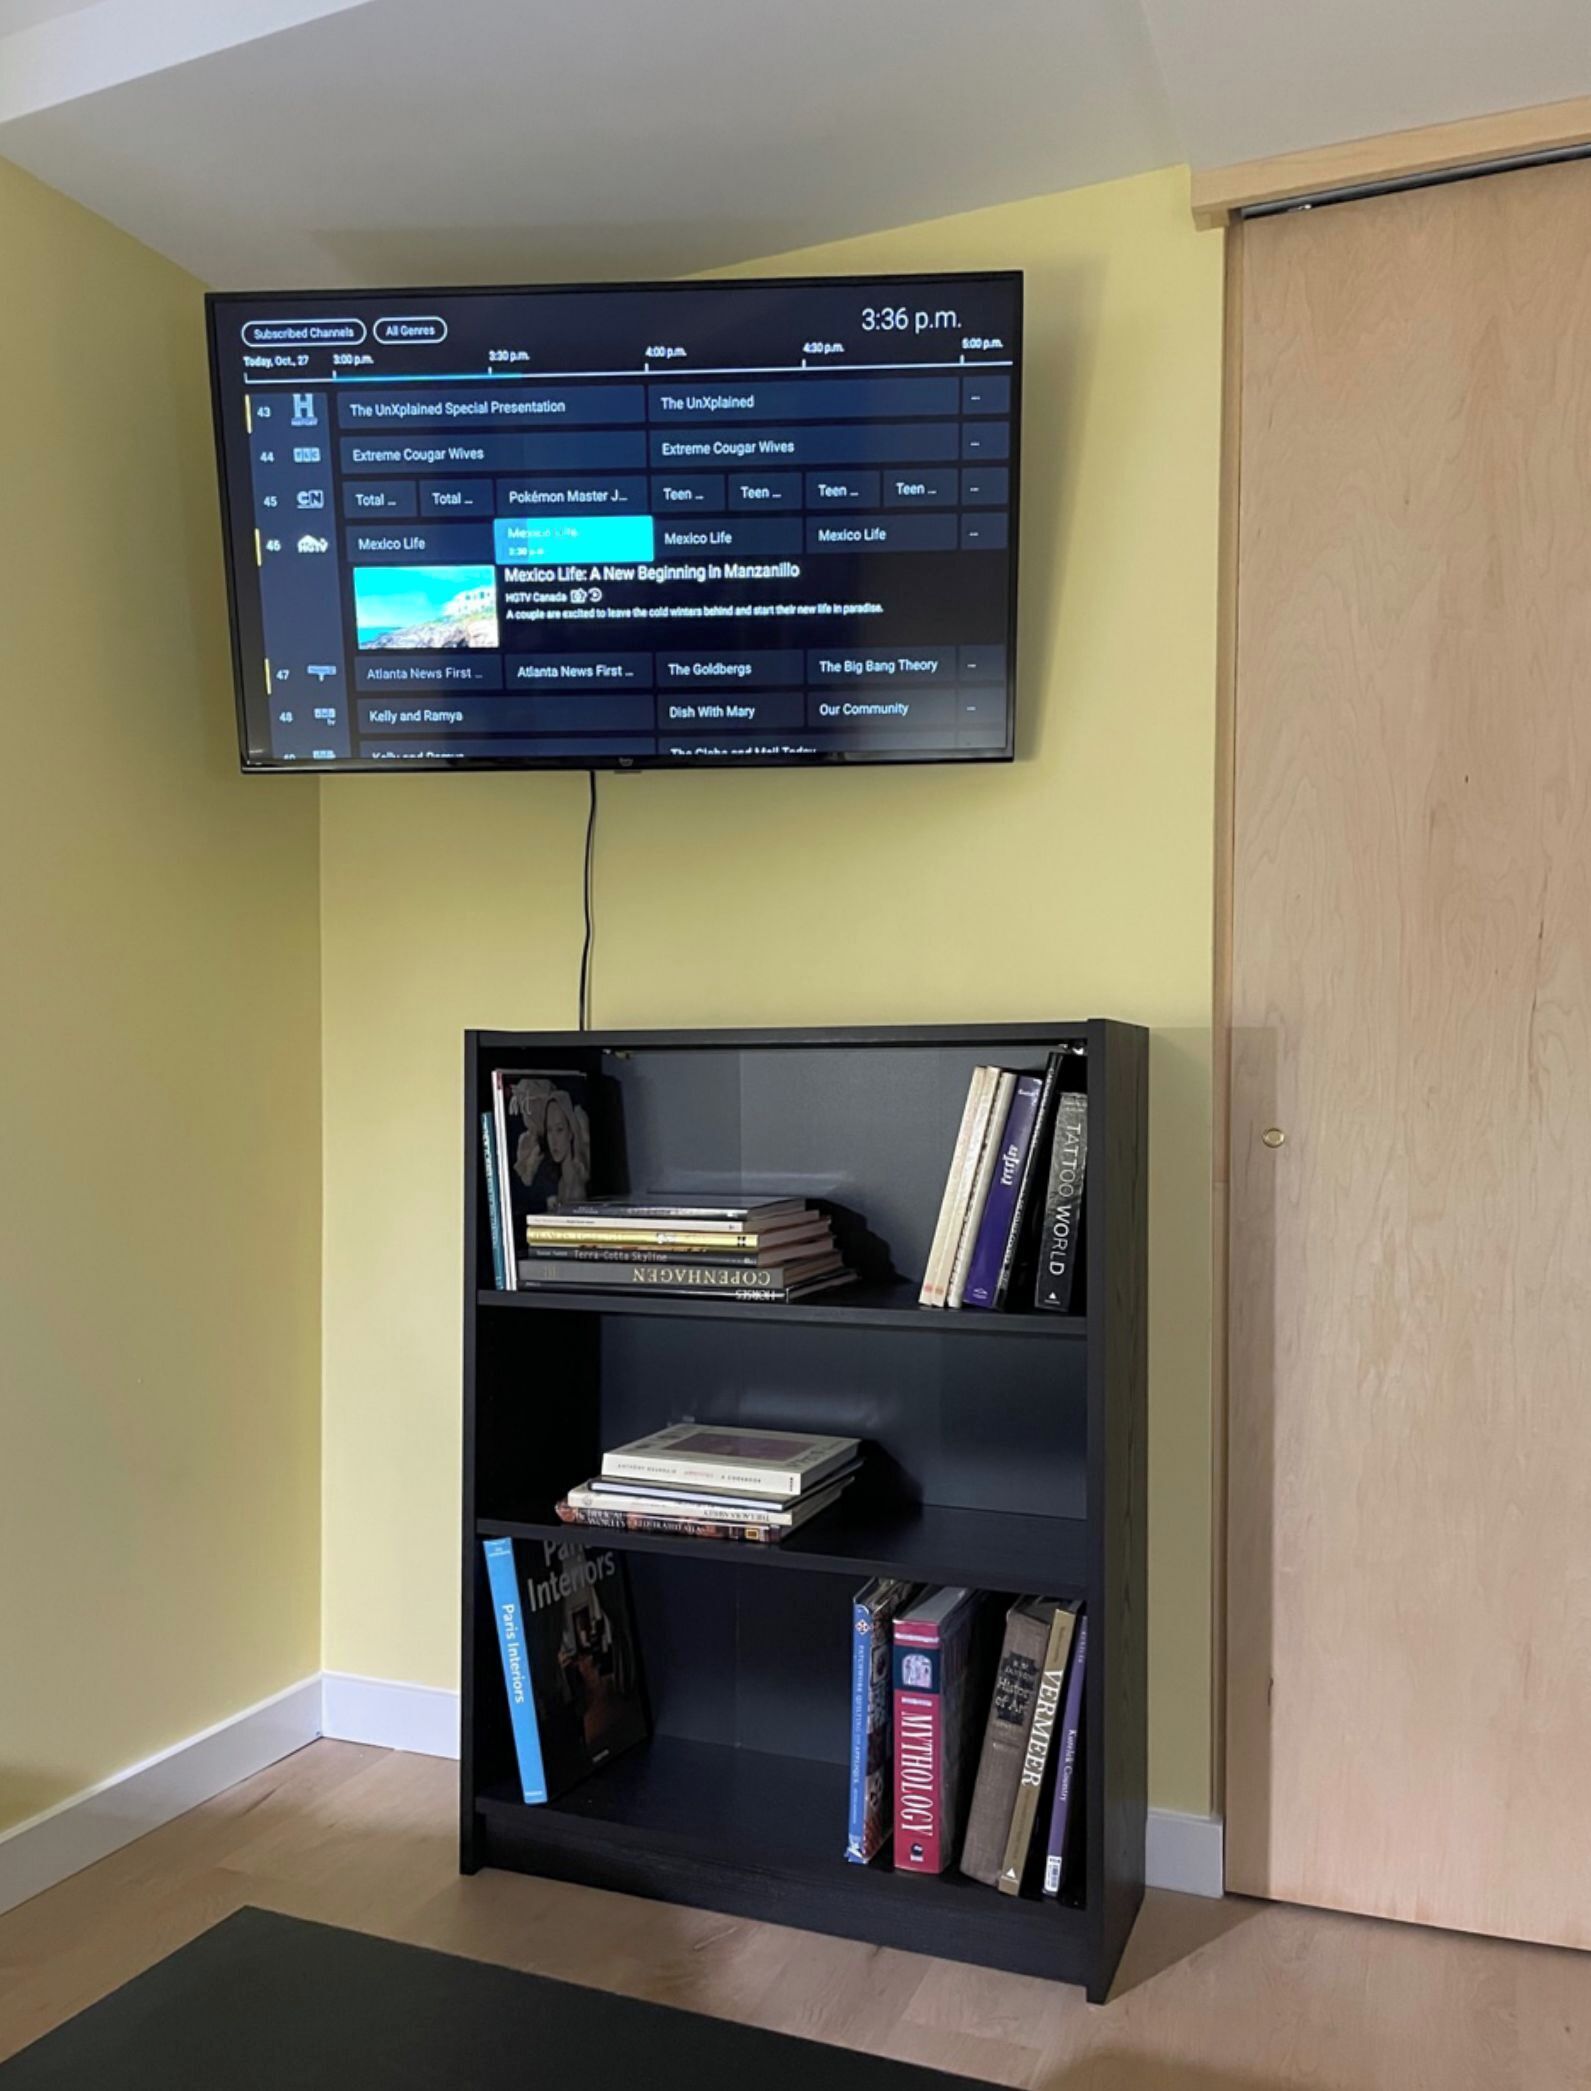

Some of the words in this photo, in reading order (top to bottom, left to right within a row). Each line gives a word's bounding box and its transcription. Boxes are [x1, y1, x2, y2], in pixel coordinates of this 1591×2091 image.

[862, 307, 908, 331] 3:36
[915, 309, 962, 333] p.m.
[254, 326, 308, 340] Subscribed
[309, 326, 354, 339] Channels
[386, 325, 398, 337] All
[400, 324, 436, 337] Genres
[350, 403, 373, 417] The
[375, 402, 443, 419] UnXplained
[445, 401, 489, 416] Special
[491, 399, 566, 414] Presentation
[661, 396, 684, 410] The
[686, 395, 756, 411] UnXplained
[257, 406, 271, 418] 43
[352, 448, 401, 462] Extreme
[403, 448, 446, 464] Cougar
[448, 447, 484, 460] Wives
[662, 442, 711, 456] Extreme
[713, 441, 757, 457] Cougar
[759, 440, 795, 453] Wives
[260, 451, 275, 463] 44
[664, 488, 693, 501] Teen
[740, 486, 770, 499] Teen
[818, 484, 848, 497] Teen
[896, 482, 926, 495] Teen
[264, 496, 278, 508] 45
[356, 493, 386, 506] Total
[433, 492, 462, 505] Total
[509, 490, 565, 504] Pokémon
[567, 490, 609, 503] Master
[664, 532, 708, 545] Mexico
[709, 531, 733, 544] Life
[818, 529, 861, 542] Mexico
[862, 528, 887, 541] Life
[358, 538, 401, 551] Mexico
[403, 537, 426, 550] Life
[505, 567, 555, 582] Mexico
[556, 566, 588, 582] Life:
[589, 566, 602, 581] A
[603, 566, 635, 581] New
[637, 565, 706, 583] Beginning
[708, 564, 722, 579] in
[723, 562, 801, 579] Manzanillo
[366, 668, 409, 680] Atlanta
[411, 668, 443, 679] News
[445, 667, 472, 679] First
[517, 666, 559, 678] Atlanta
[560, 665, 594, 678] News
[596, 665, 623, 677] First
[668, 664, 691, 675] The
[692, 662, 752, 678] Goldbergs
[819, 661, 841, 673] The
[843, 660, 864, 675] Big
[865, 660, 896, 674] Bang
[897, 658, 939, 673] Theory
[276, 669, 290, 681] 47
[369, 710, 398, 724] Kelly
[400, 710, 422, 722] and
[424, 710, 463, 723] Ramya
[669, 706, 694, 719] Dish
[695, 705, 725, 718] With
[726, 705, 756, 720] Mary
[819, 704, 841, 716] Our
[842, 702, 910, 718] Community
[1059, 1122, 1081, 1198] TATTOO
[1050, 1204, 1073, 1276] WORLD
[630, 1251, 668, 1265] Skyline
[632, 1267, 771, 1286] COPENHAGEN
[527, 1551, 615, 1612] Interiors
[501, 1603, 519, 1640] Paris
[507, 1641, 524, 1705] Interiors
[1022, 1669, 1064, 1787] VERMEER
[900, 1711, 934, 1837] MYTHOLOGY
[1058, 1765, 1073, 1802] Country
